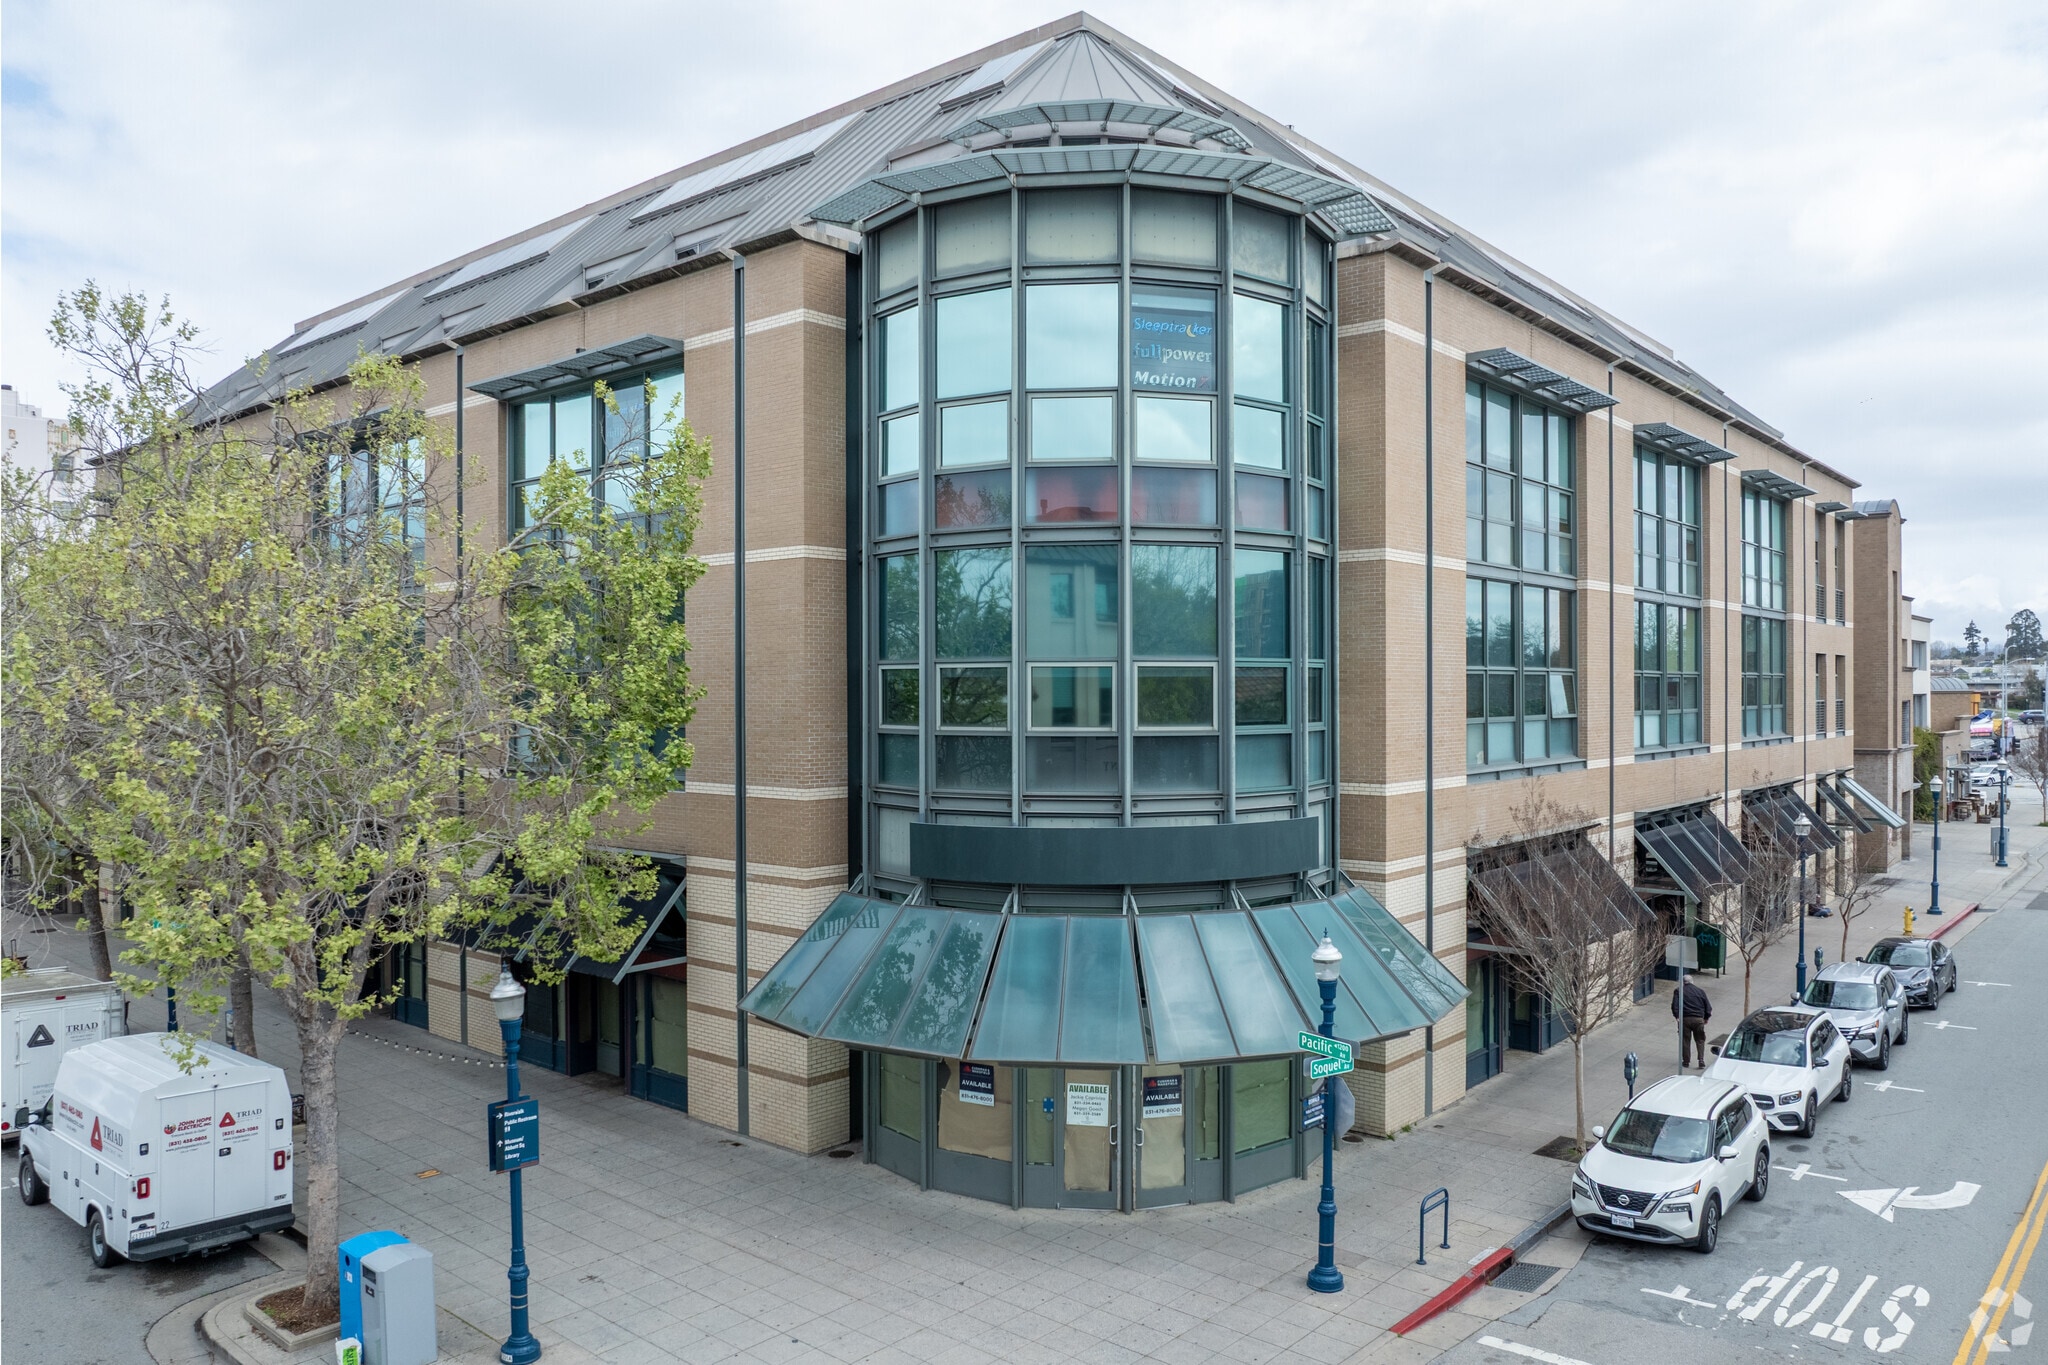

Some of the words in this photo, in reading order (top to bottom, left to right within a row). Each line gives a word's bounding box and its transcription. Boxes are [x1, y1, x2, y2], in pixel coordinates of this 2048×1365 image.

[1134, 317, 1212, 338] Sleeptracker
[1134, 343, 1212, 364] fullpower
[66, 1022, 99, 1033] TRIAD
[1301, 1035, 1333, 1054] Pacific
[1313, 1059, 1341, 1075] Soquel
[961, 1079, 993, 1090] AVAILABLE
[1069, 1084, 1108, 1094] AVAILABLE
[1145, 1092, 1180, 1102] AVAILABLE
[236, 1108, 262, 1118] TRIAD
[178, 1119, 196, 1127] JOHN
[196, 1115, 212, 1123] HOPE
[103, 1124, 123, 1147] TRIAD
[160, 1220, 169, 1230] 22
[1726, 1260, 1930, 1354] STOP
